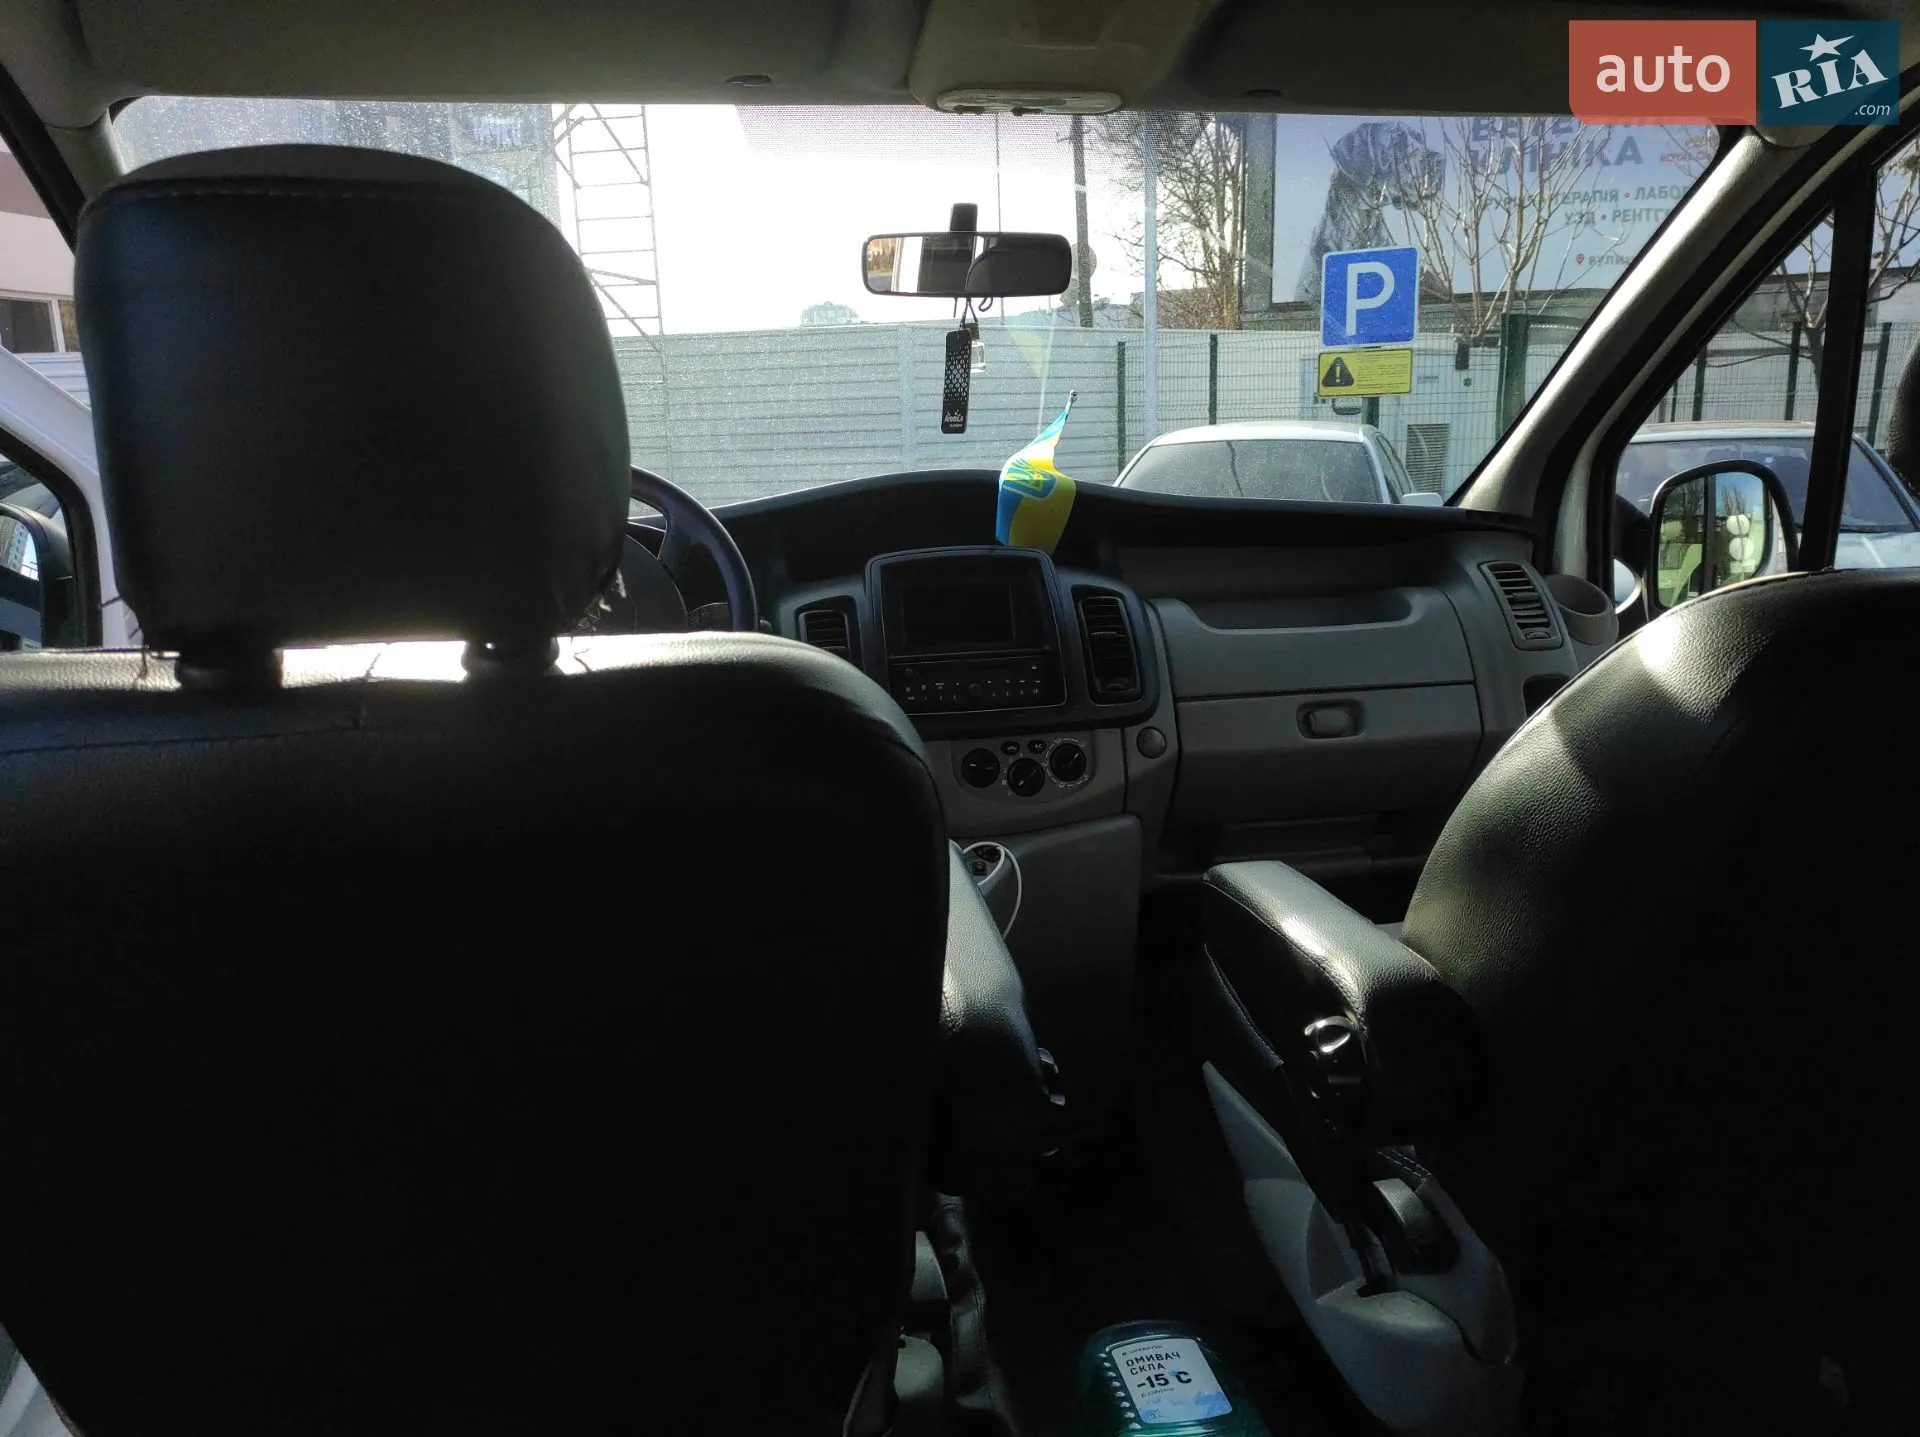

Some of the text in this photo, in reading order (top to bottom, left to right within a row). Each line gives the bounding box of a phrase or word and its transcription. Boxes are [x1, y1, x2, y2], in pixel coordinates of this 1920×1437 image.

[1345, 261, 1395, 337] P
[1126, 1351, 1182, 1367] ОМИВАЧ
[1130, 1362, 1166, 1375] СКЛА
